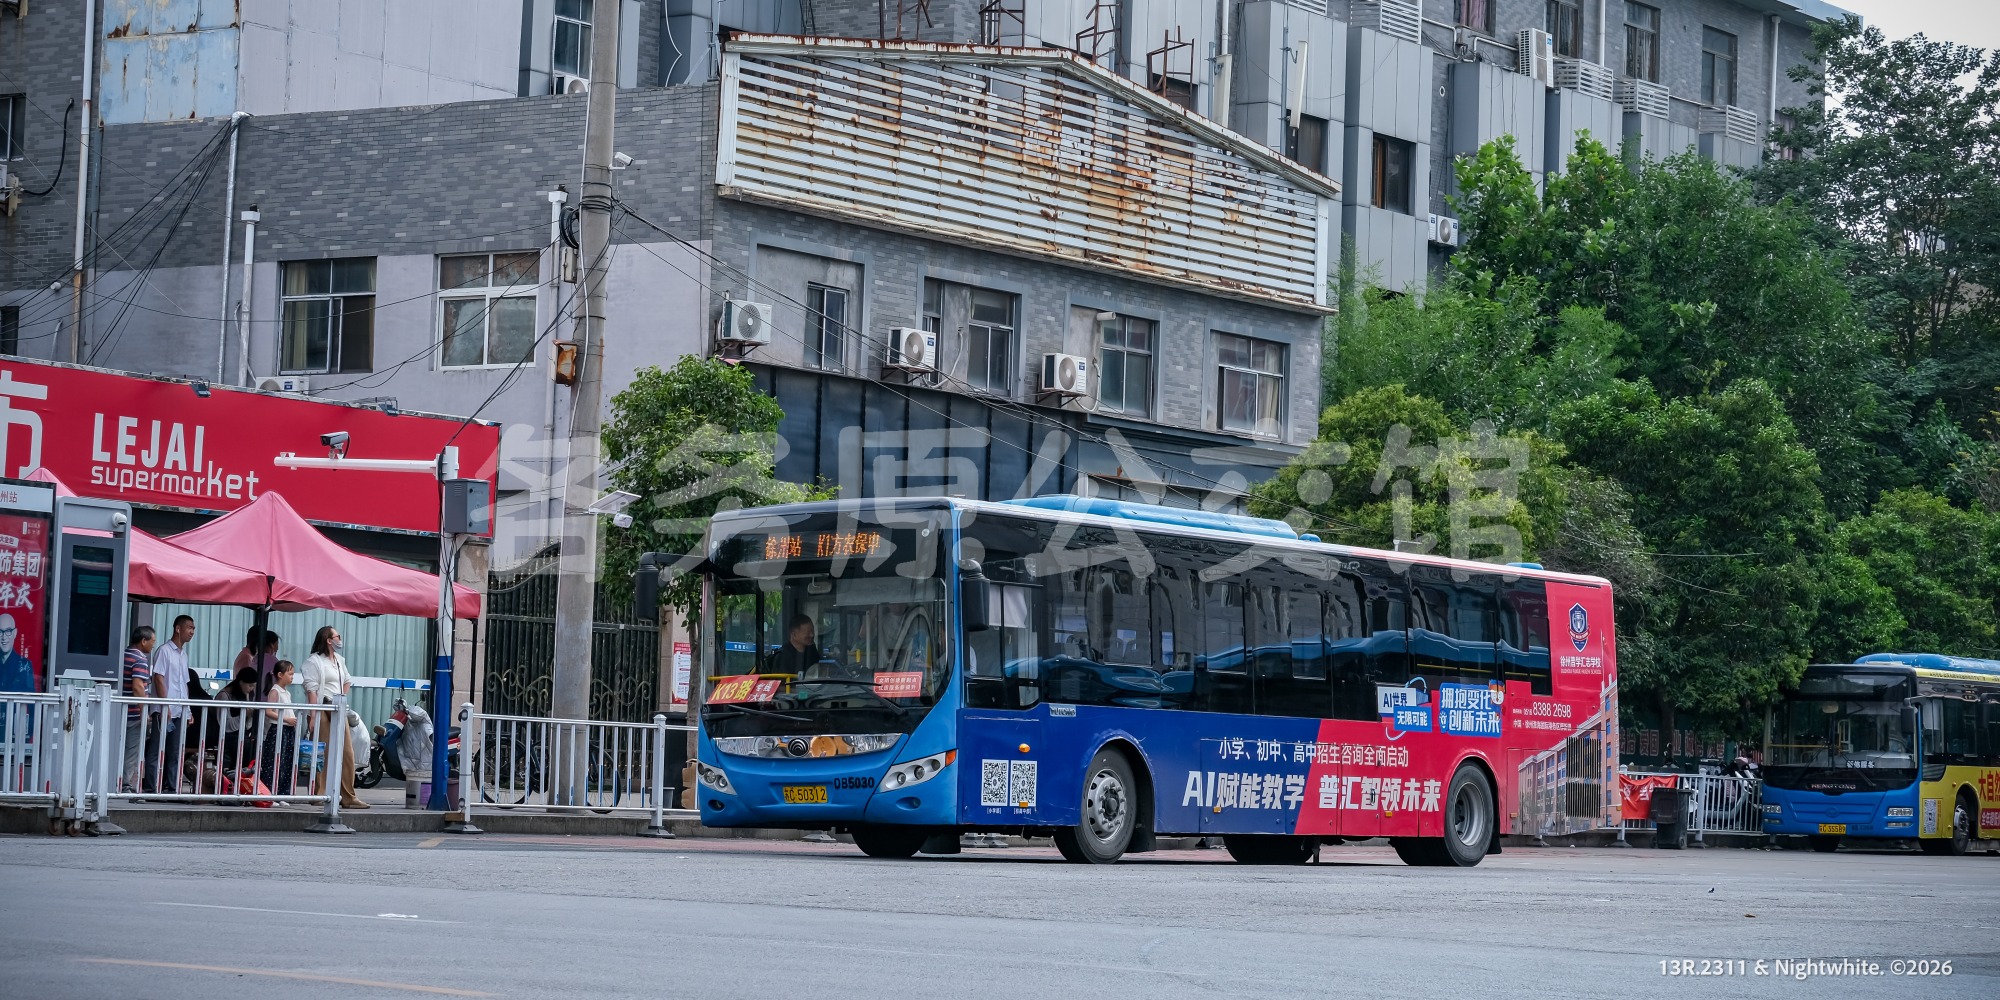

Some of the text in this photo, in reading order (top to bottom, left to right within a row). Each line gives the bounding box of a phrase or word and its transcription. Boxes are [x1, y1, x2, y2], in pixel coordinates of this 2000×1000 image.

[92, 412, 205, 473] LEJAI
[90, 461, 260, 500] supermarket
[765, 534, 802, 560] 徐州站
[710, 678, 755, 702] K13路
[1383, 692, 1408, 708] AI世界
[1441, 688, 1492, 710] 拥抱变化
[1397, 711, 1428, 728] 无限可能
[1449, 710, 1500, 733] 创新未来
[1532, 701, 1552, 717] 8388
[1553, 703, 1572, 718] 2698
[1218, 737, 1409, 768] 小学、初中、高中招生咨询全面启动
[1640, 728, 1660, 757] 爱国
[834, 776, 875, 790] DB5030
[1182, 771, 1442, 812] AI赋能教学 普汇智领未来
